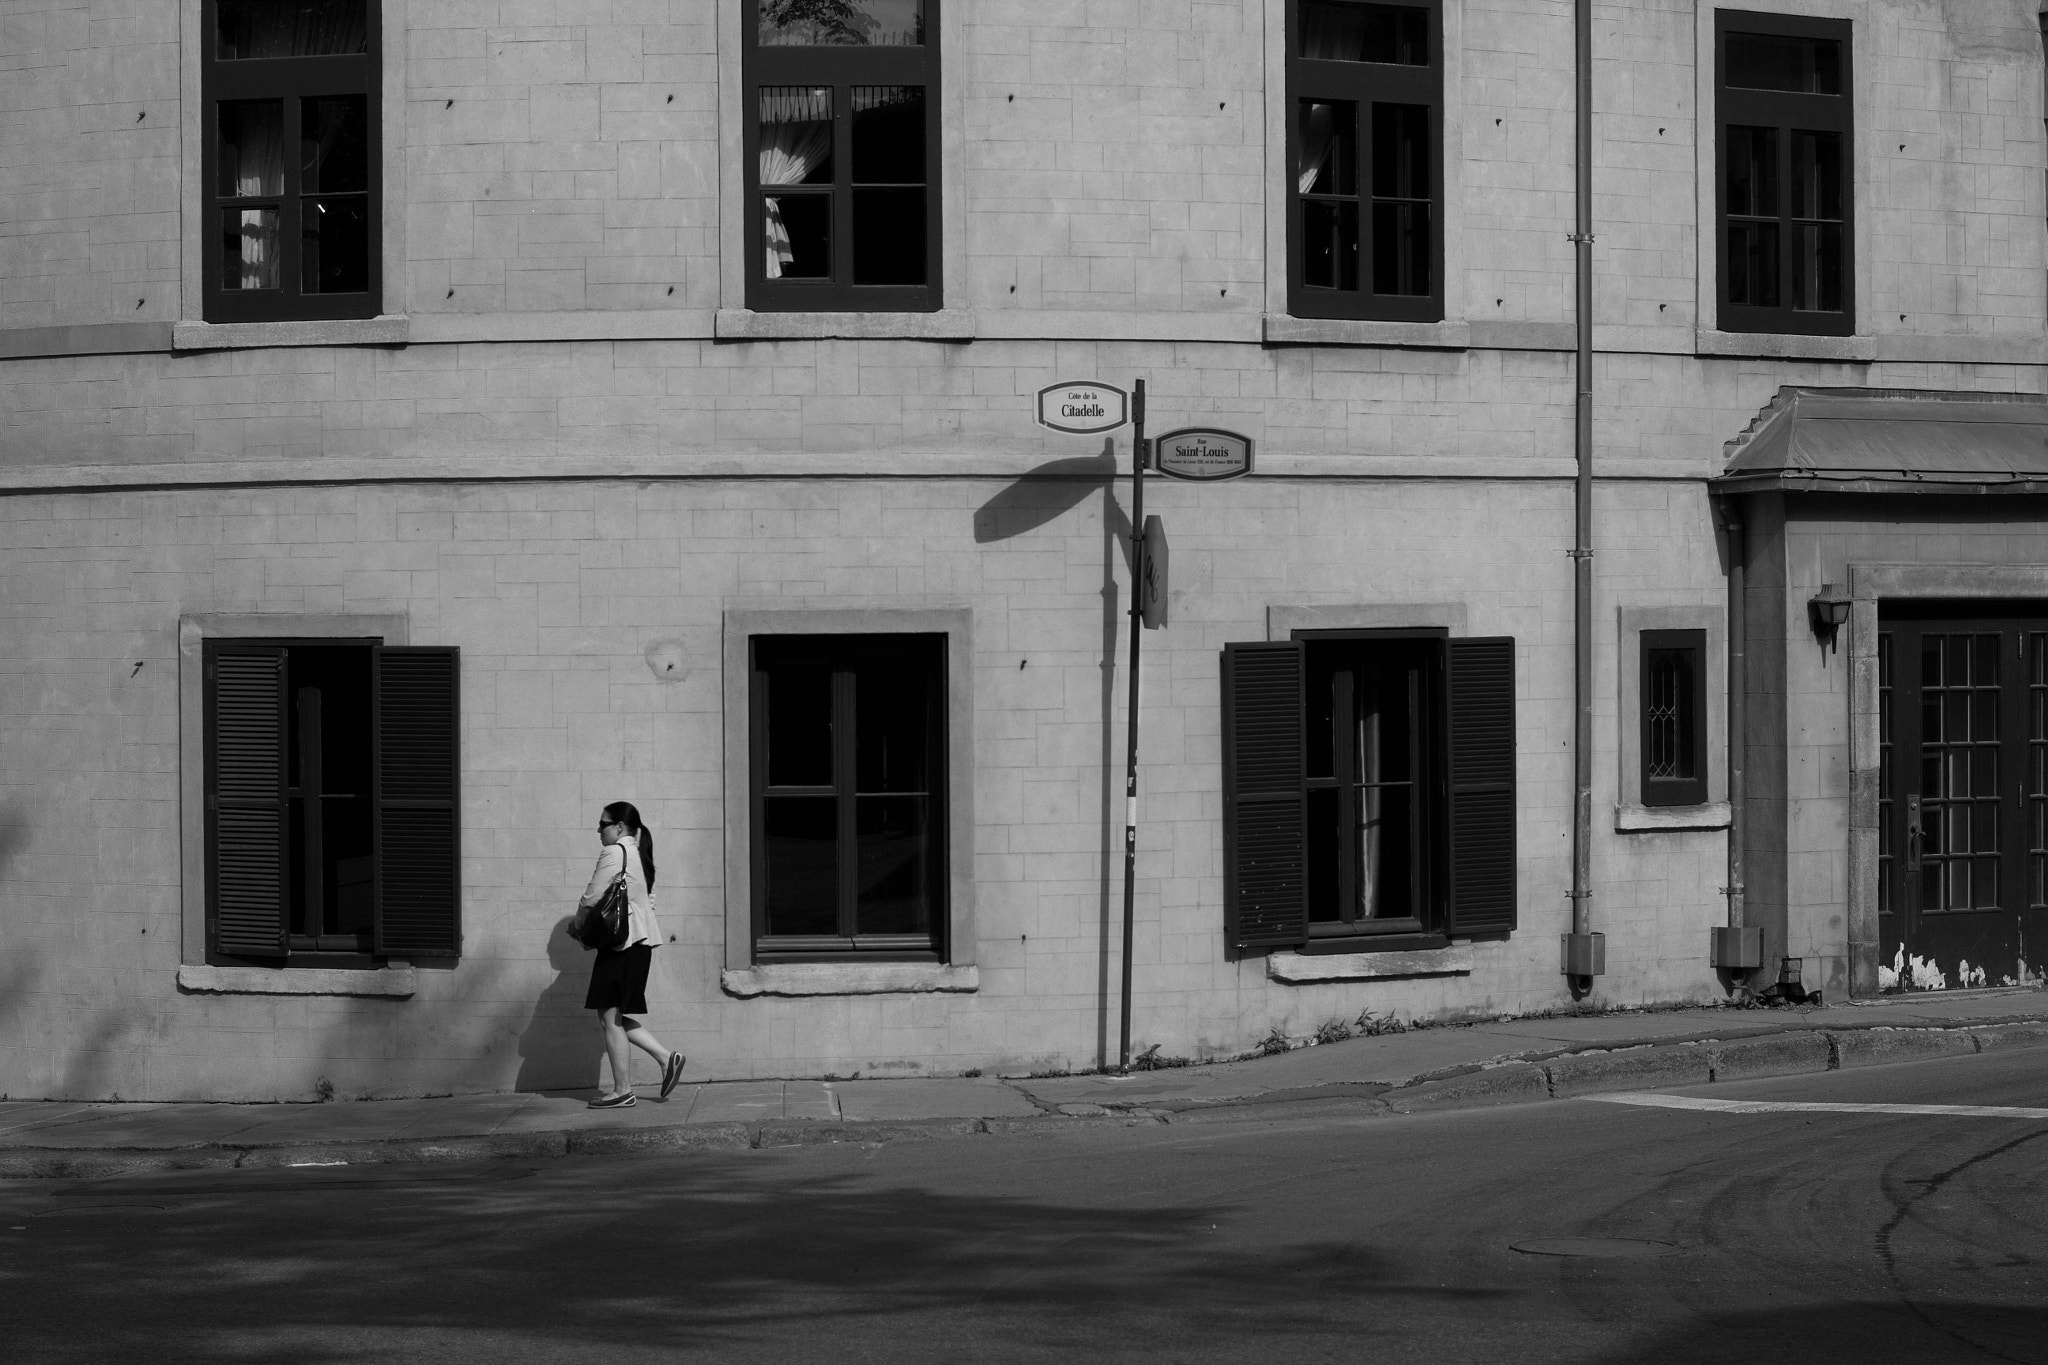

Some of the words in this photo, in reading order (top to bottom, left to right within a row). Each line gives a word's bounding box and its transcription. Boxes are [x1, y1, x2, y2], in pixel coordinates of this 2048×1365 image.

[1082, 392, 1091, 400] de
[1092, 392, 1098, 400] la
[1061, 404, 1105, 417] Citadelle
[1175, 445, 1229, 457] Saint-Louis
